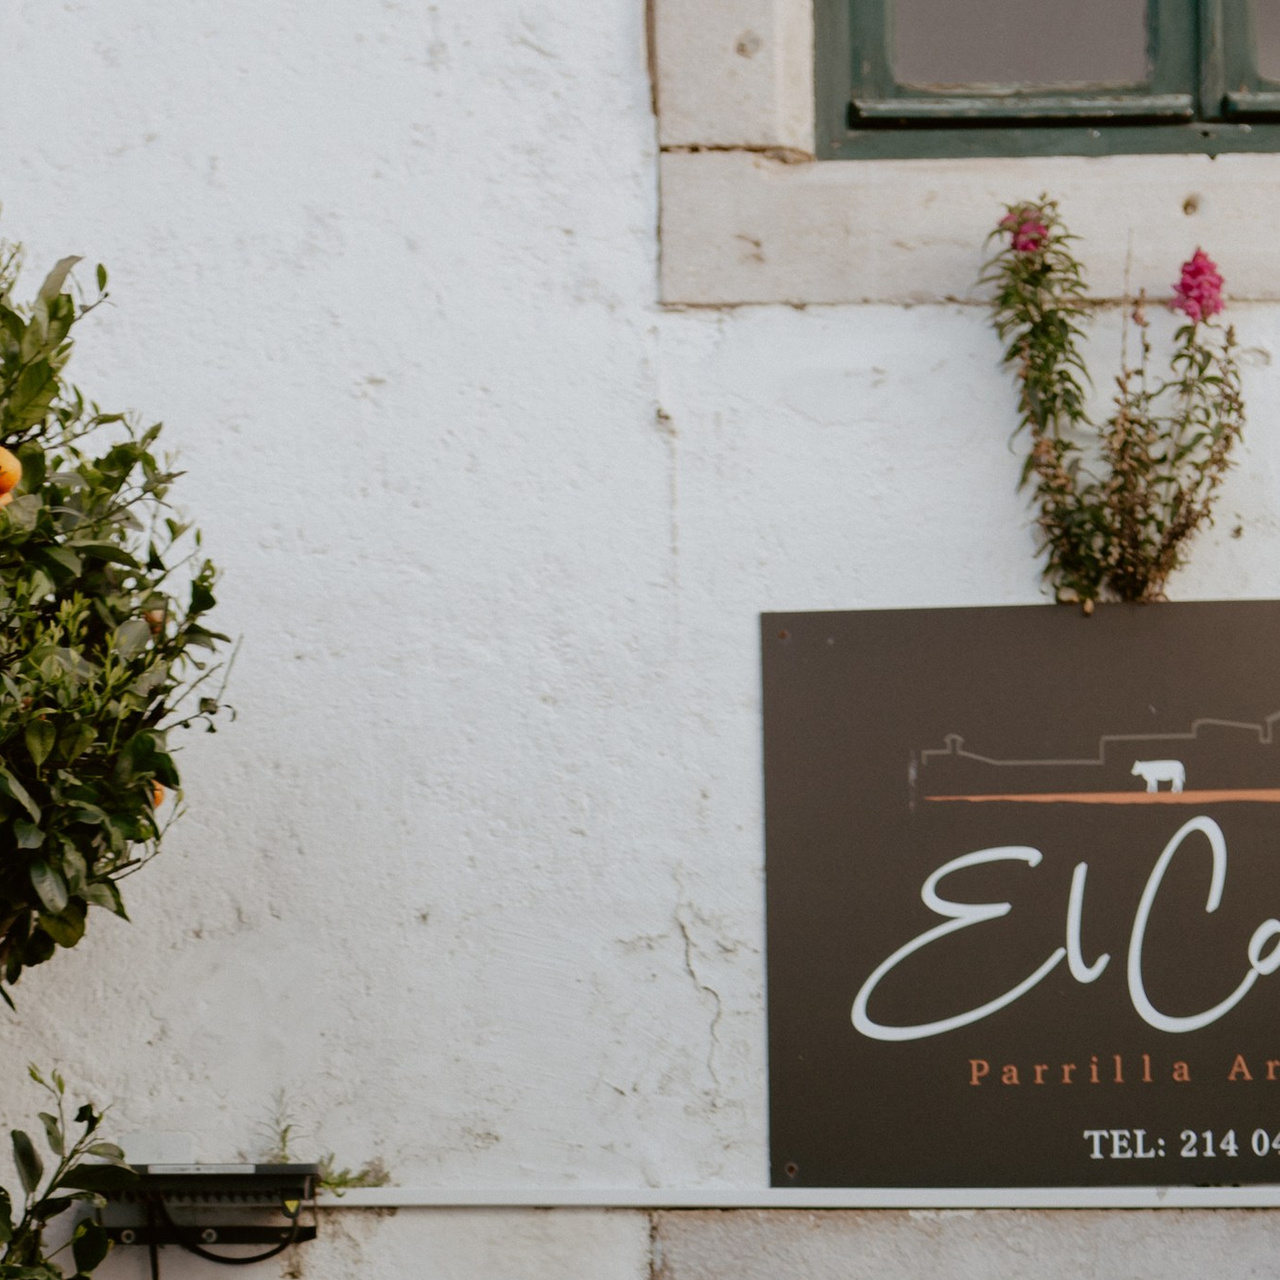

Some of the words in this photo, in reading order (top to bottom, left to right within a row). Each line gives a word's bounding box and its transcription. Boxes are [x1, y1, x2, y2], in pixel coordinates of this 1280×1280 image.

[851, 846, 1111, 1041] El
[969, 1054, 1191, 1085] Parrilla
[1083, 1128, 1166, 1159] TEL:
[1179, 1128, 1239, 1157] 214
